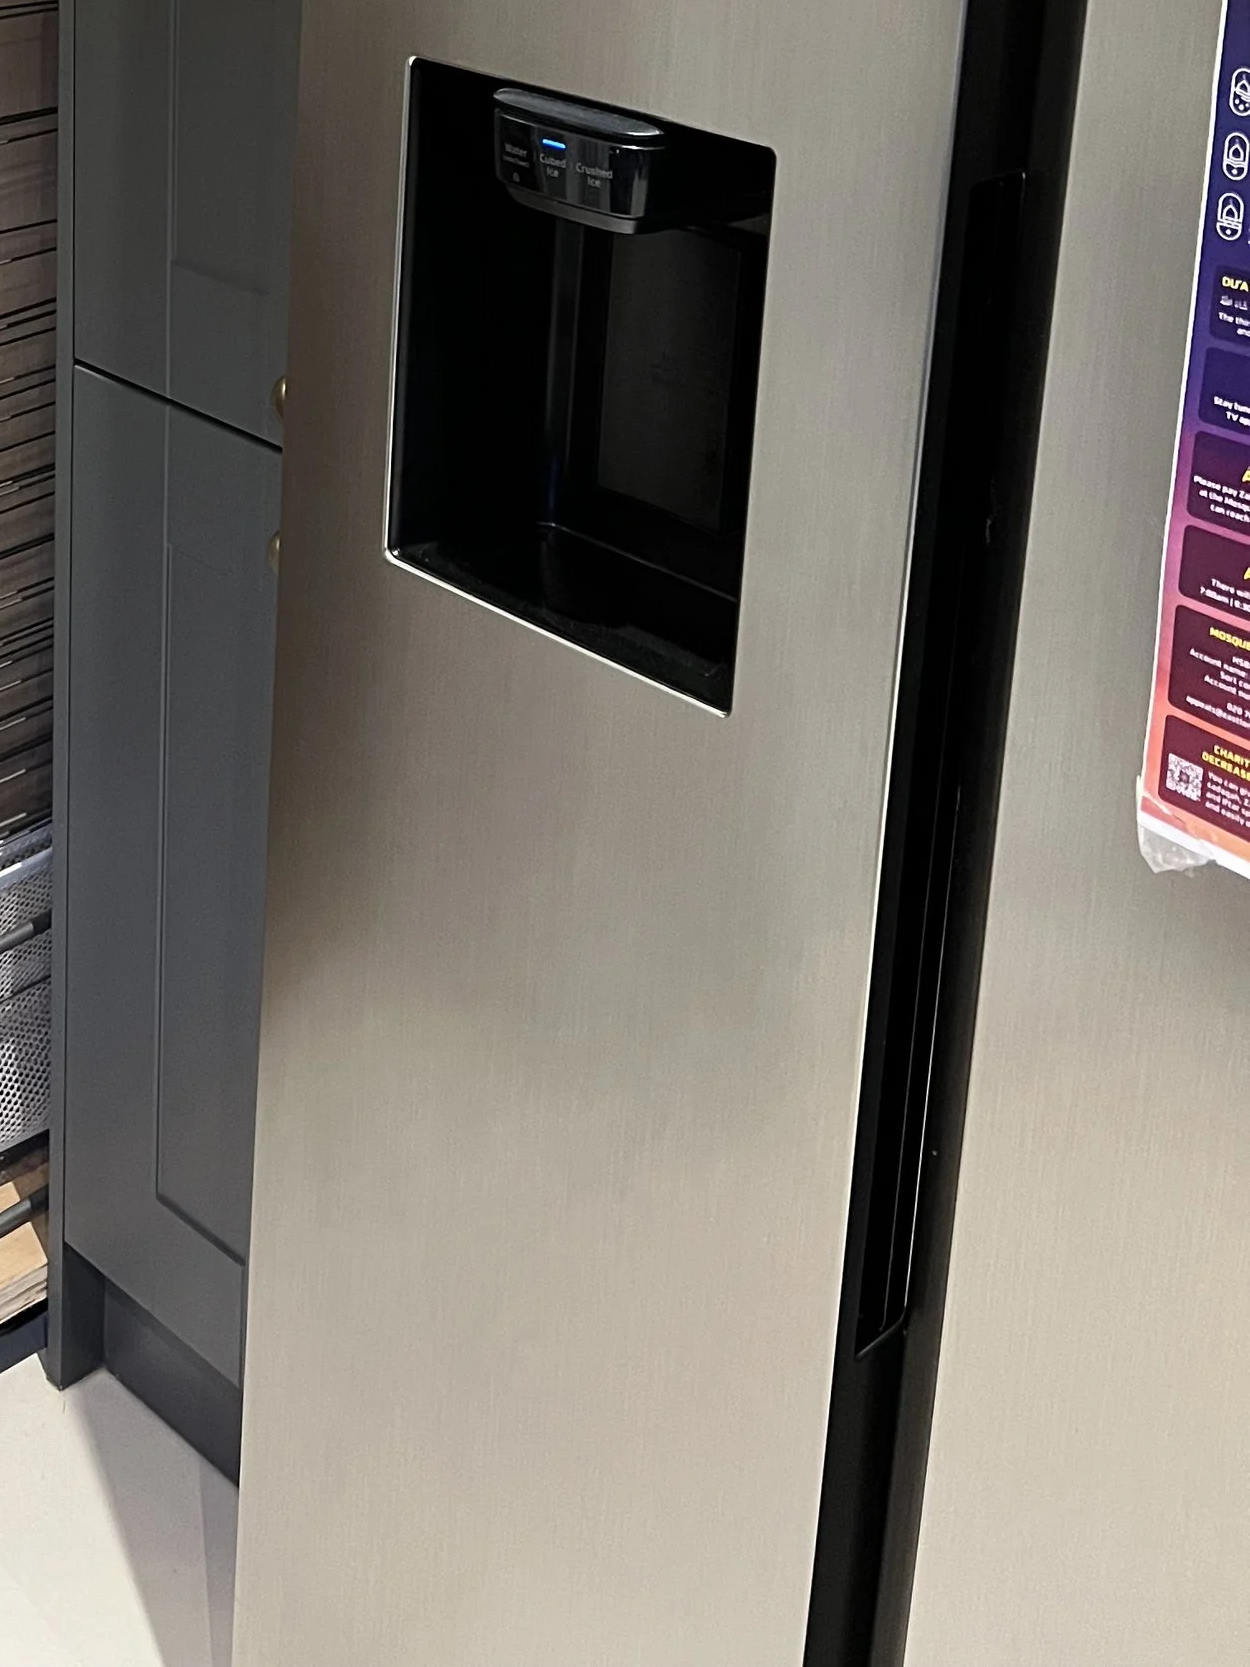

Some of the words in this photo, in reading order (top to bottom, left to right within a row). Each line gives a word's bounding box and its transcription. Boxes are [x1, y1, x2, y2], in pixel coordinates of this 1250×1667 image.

[539, 152, 567, 169] Cubed
[546, 166, 559, 177] Ice
[575, 162, 613, 179] Crushed
[587, 176, 601, 188] Ice
[1226, 411, 1239, 421] TV
[1193, 475, 1222, 491] Please
[1221, 485, 1238, 498] pay
[1211, 578, 1235, 594] There
[1189, 648, 1222, 668] Account
[1204, 675, 1237, 695] Account
[1220, 670, 1237, 685] Sort
